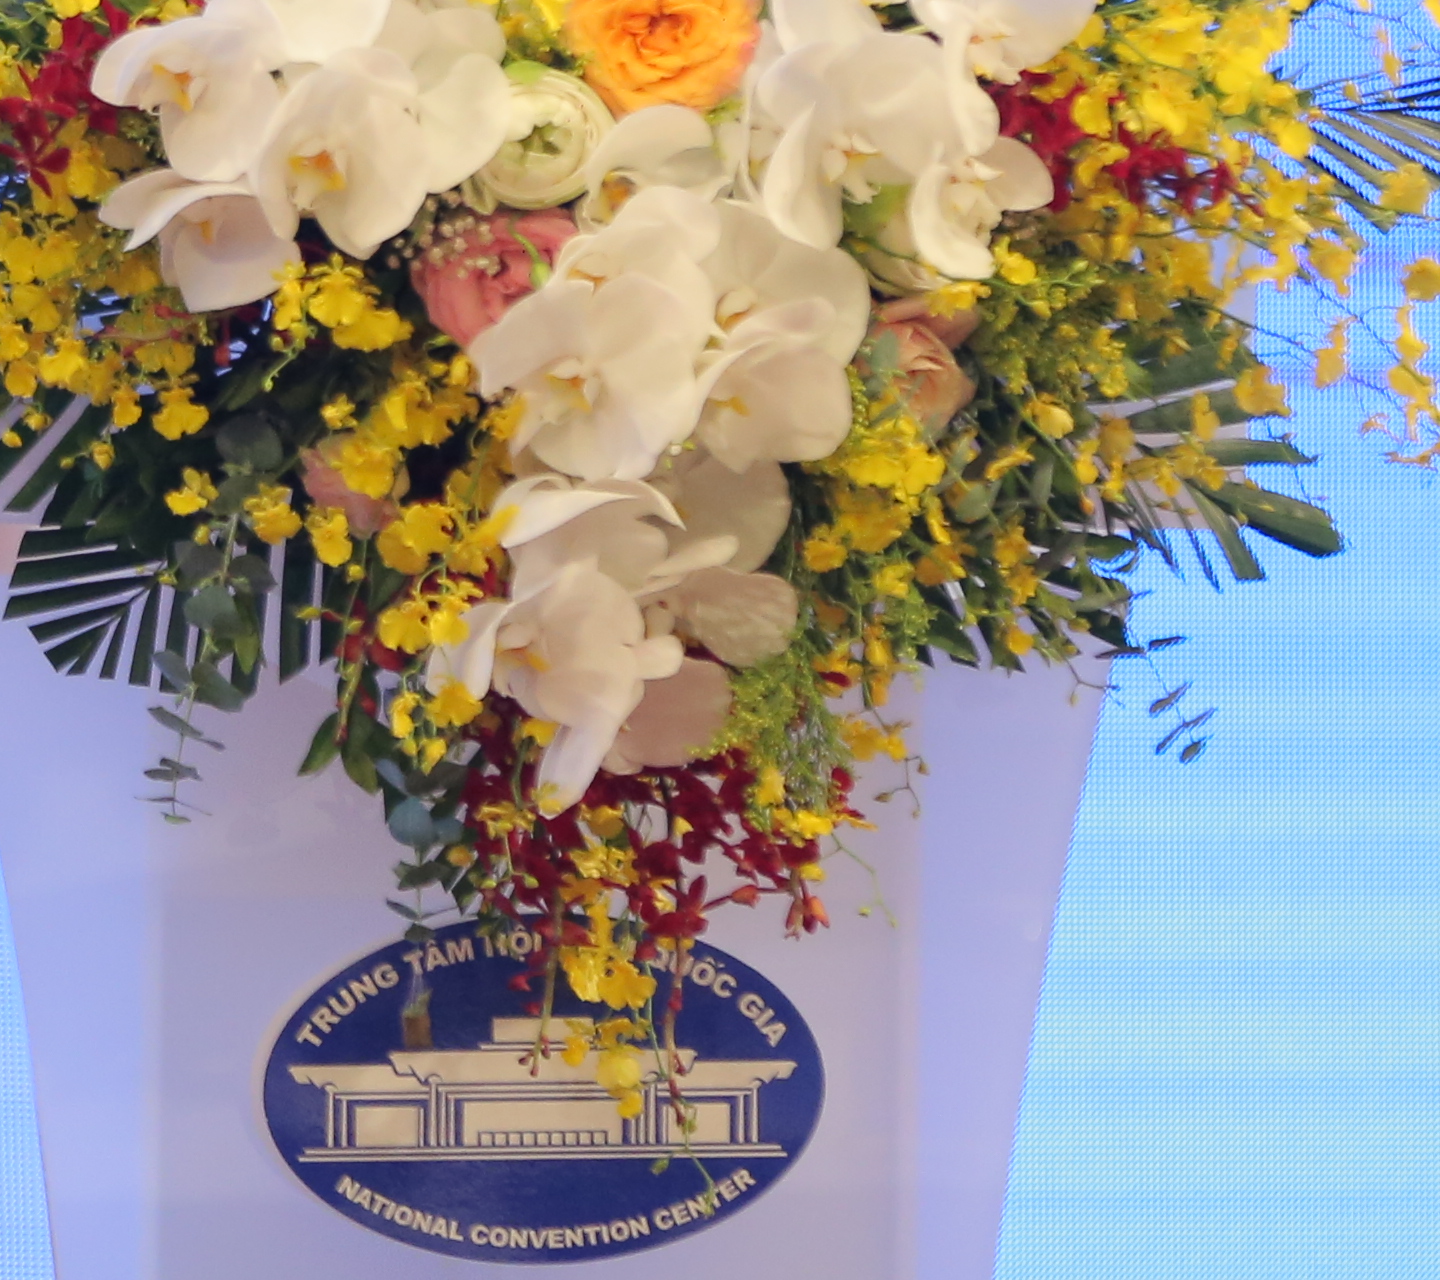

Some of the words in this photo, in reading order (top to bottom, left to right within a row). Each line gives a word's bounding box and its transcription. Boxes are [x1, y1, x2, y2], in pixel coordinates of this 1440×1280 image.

[296, 963, 400, 1047] TRUNG
[403, 938, 475, 975] TÂM
[738, 993, 787, 1048] GIA
[335, 1175, 464, 1241] NATIONAL
[470, 1216, 651, 1249] CONVENTION
[654, 1168, 757, 1231] CENTER
